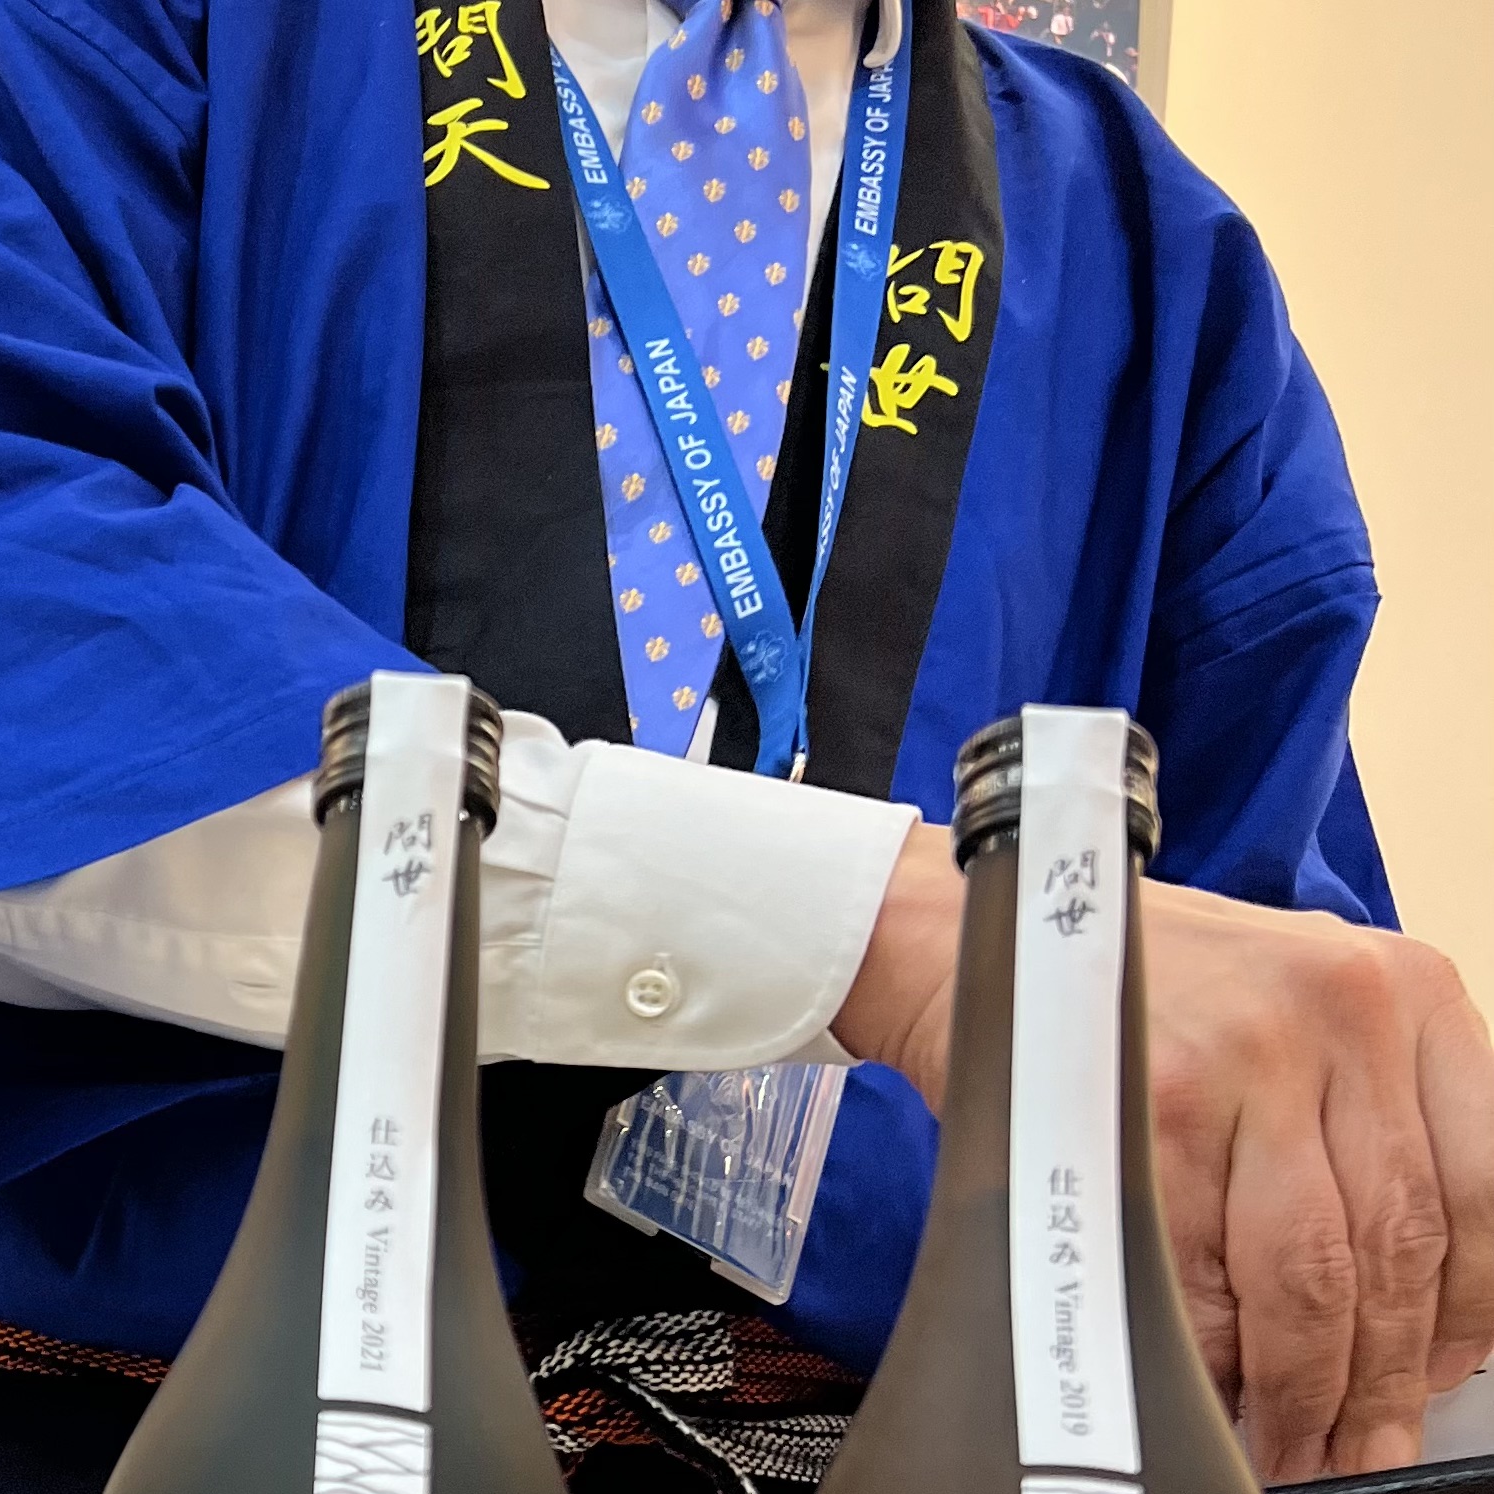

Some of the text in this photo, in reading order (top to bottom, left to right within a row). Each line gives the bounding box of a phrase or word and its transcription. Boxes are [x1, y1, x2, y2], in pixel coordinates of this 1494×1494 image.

[554, 70, 608, 184] EMBASSY
[865, 107, 889, 132] OF
[855, 136, 887, 236] EMBASSY
[831, 366, 858, 454] JAPAN
[645, 337, 763, 619] EMBASSY OF JAPAN
[356, 1117, 400, 1374] 仕込み Vintage 2021
[1047, 1165, 1092, 1437] 仕込み Vintage 2019
